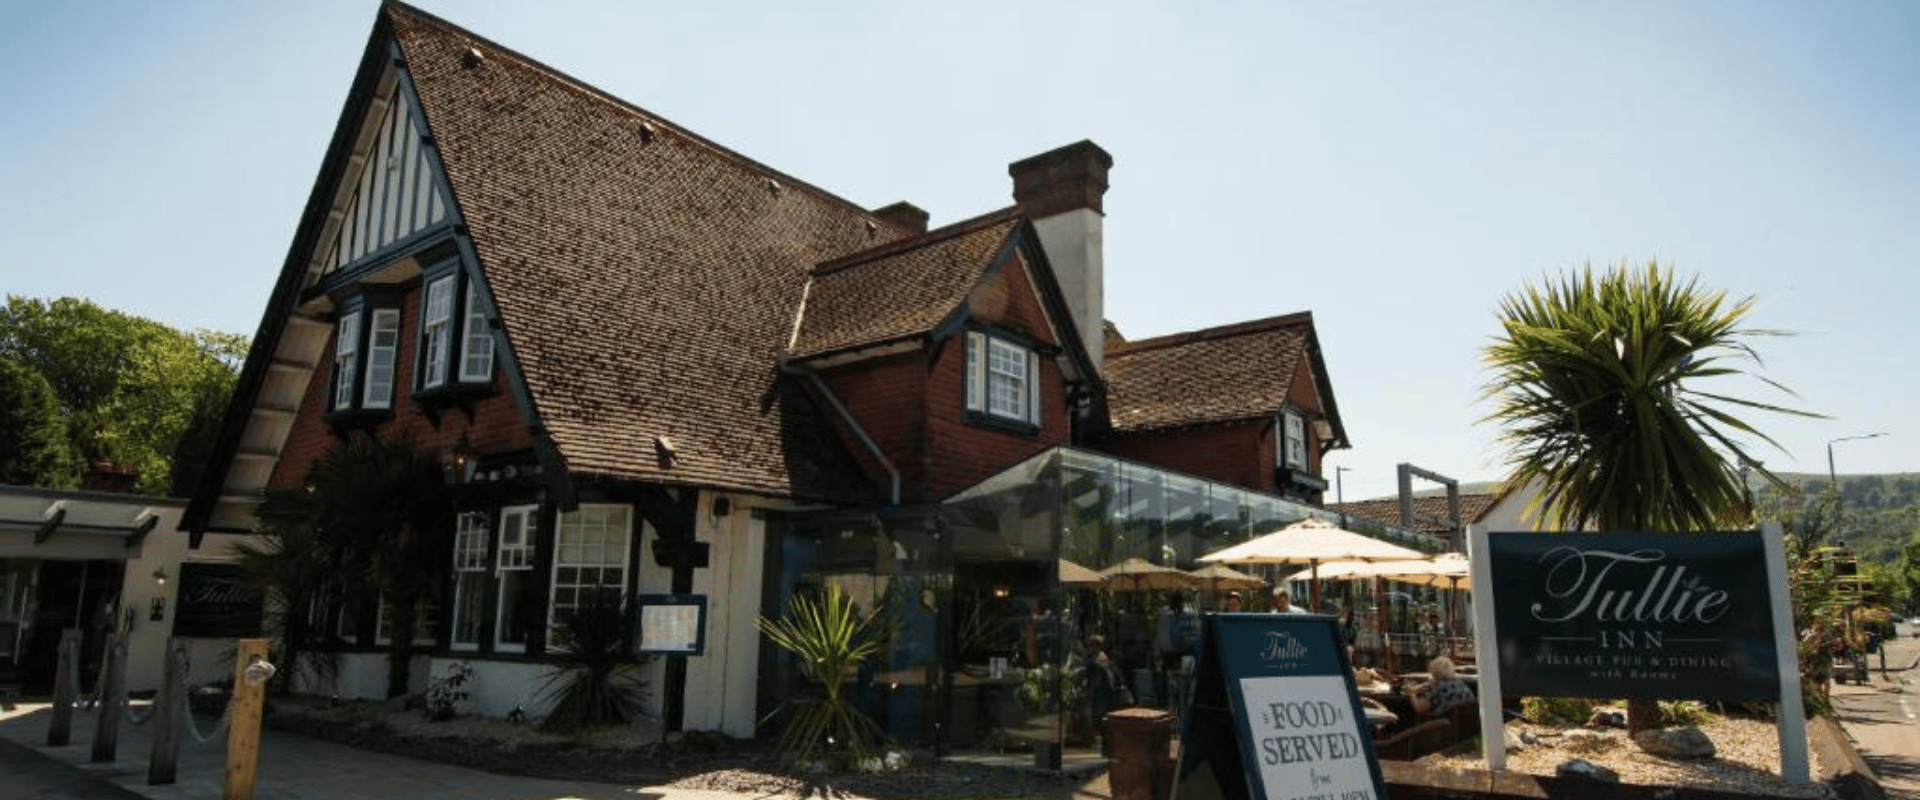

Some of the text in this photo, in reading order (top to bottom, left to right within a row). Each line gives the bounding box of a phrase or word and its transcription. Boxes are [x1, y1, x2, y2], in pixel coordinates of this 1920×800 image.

[1531, 546, 1731, 623] Tullie
[1259, 631, 1309, 660] Tullie
[1600, 631, 1664, 649] INN
[1534, 653, 1731, 667] VILLAGE PUB & DINING
[1269, 701, 1337, 730] FOOD
[1263, 733, 1359, 766] SERVED
